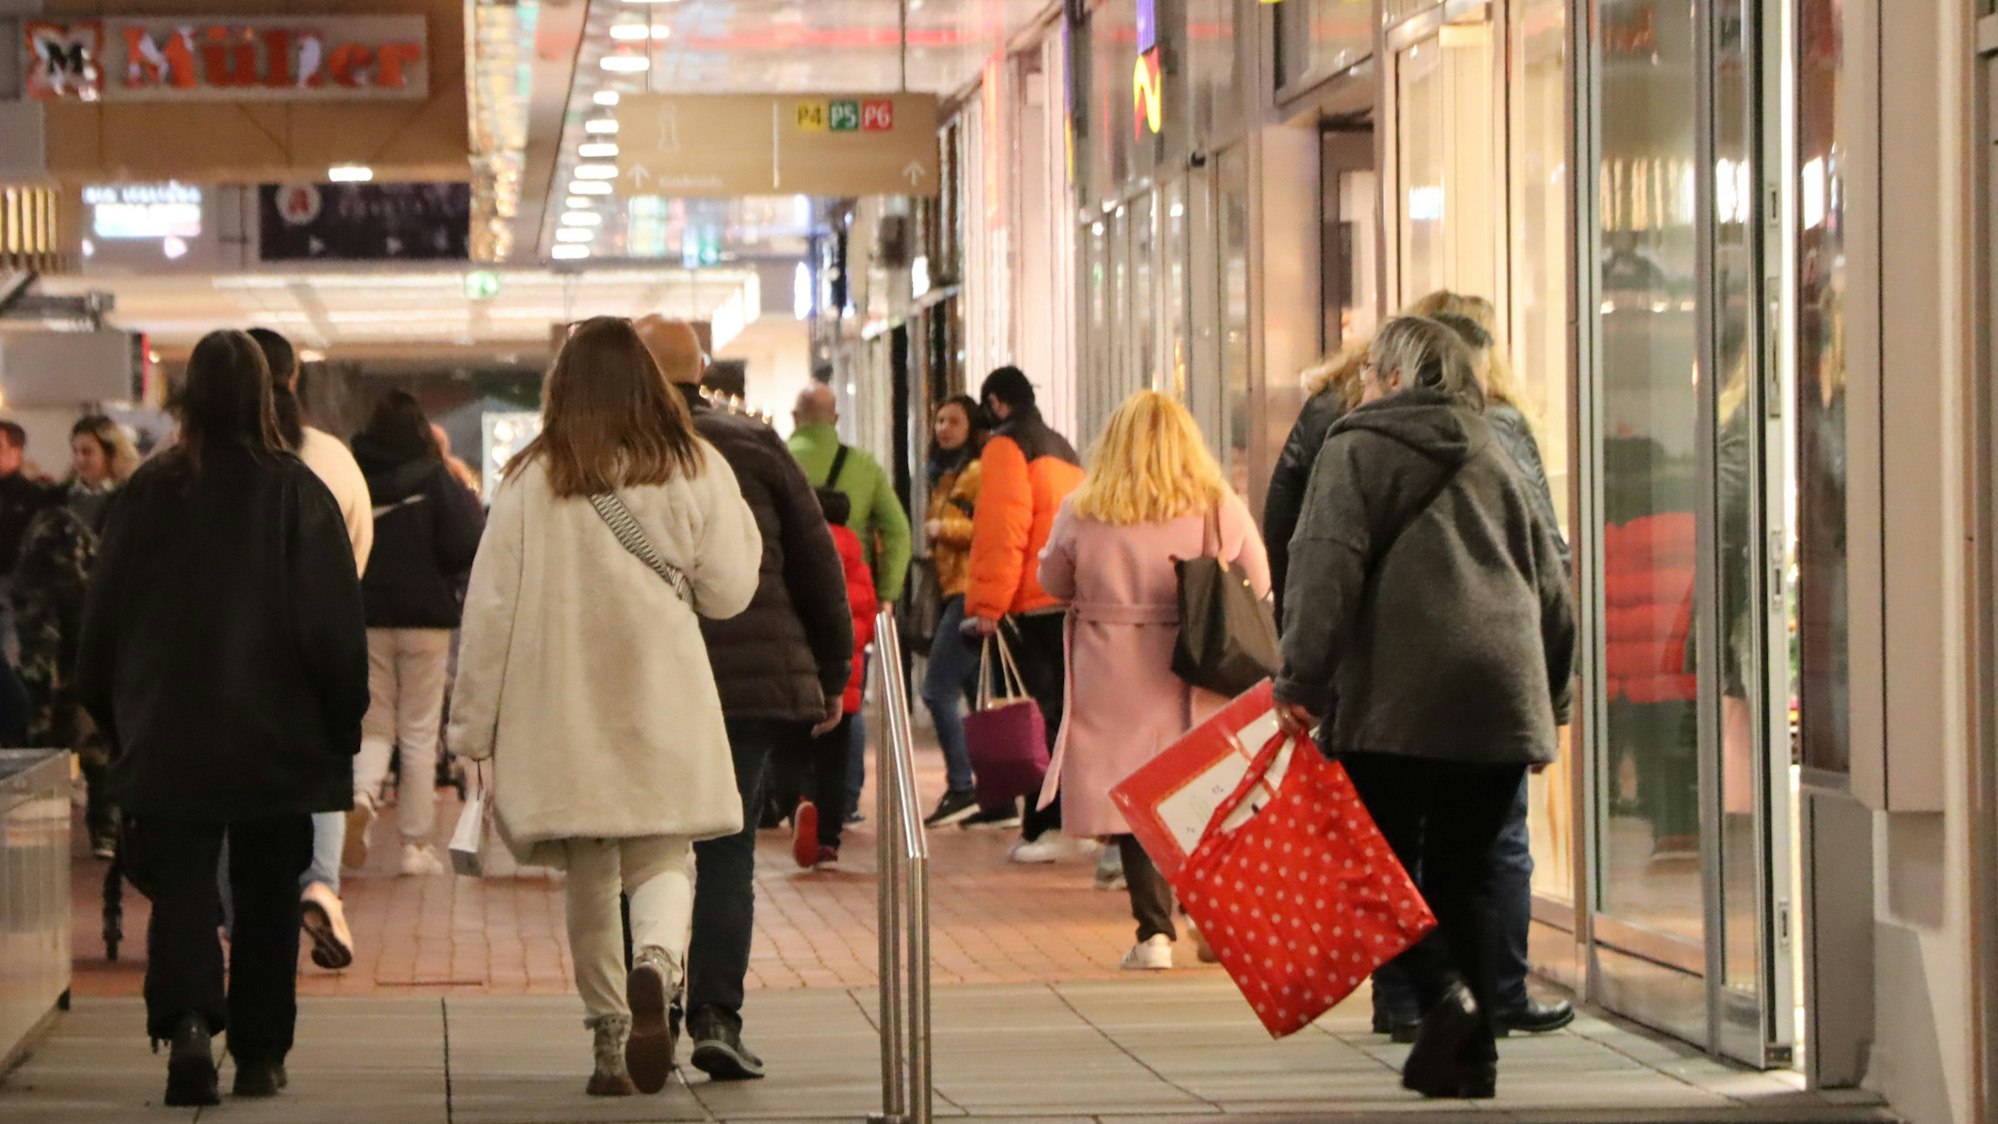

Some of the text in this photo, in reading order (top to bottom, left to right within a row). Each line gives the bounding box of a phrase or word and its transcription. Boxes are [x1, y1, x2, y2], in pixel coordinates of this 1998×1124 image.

[122, 22, 422, 89] Müller
[797, 103, 890, 129] P4 P5 P6
